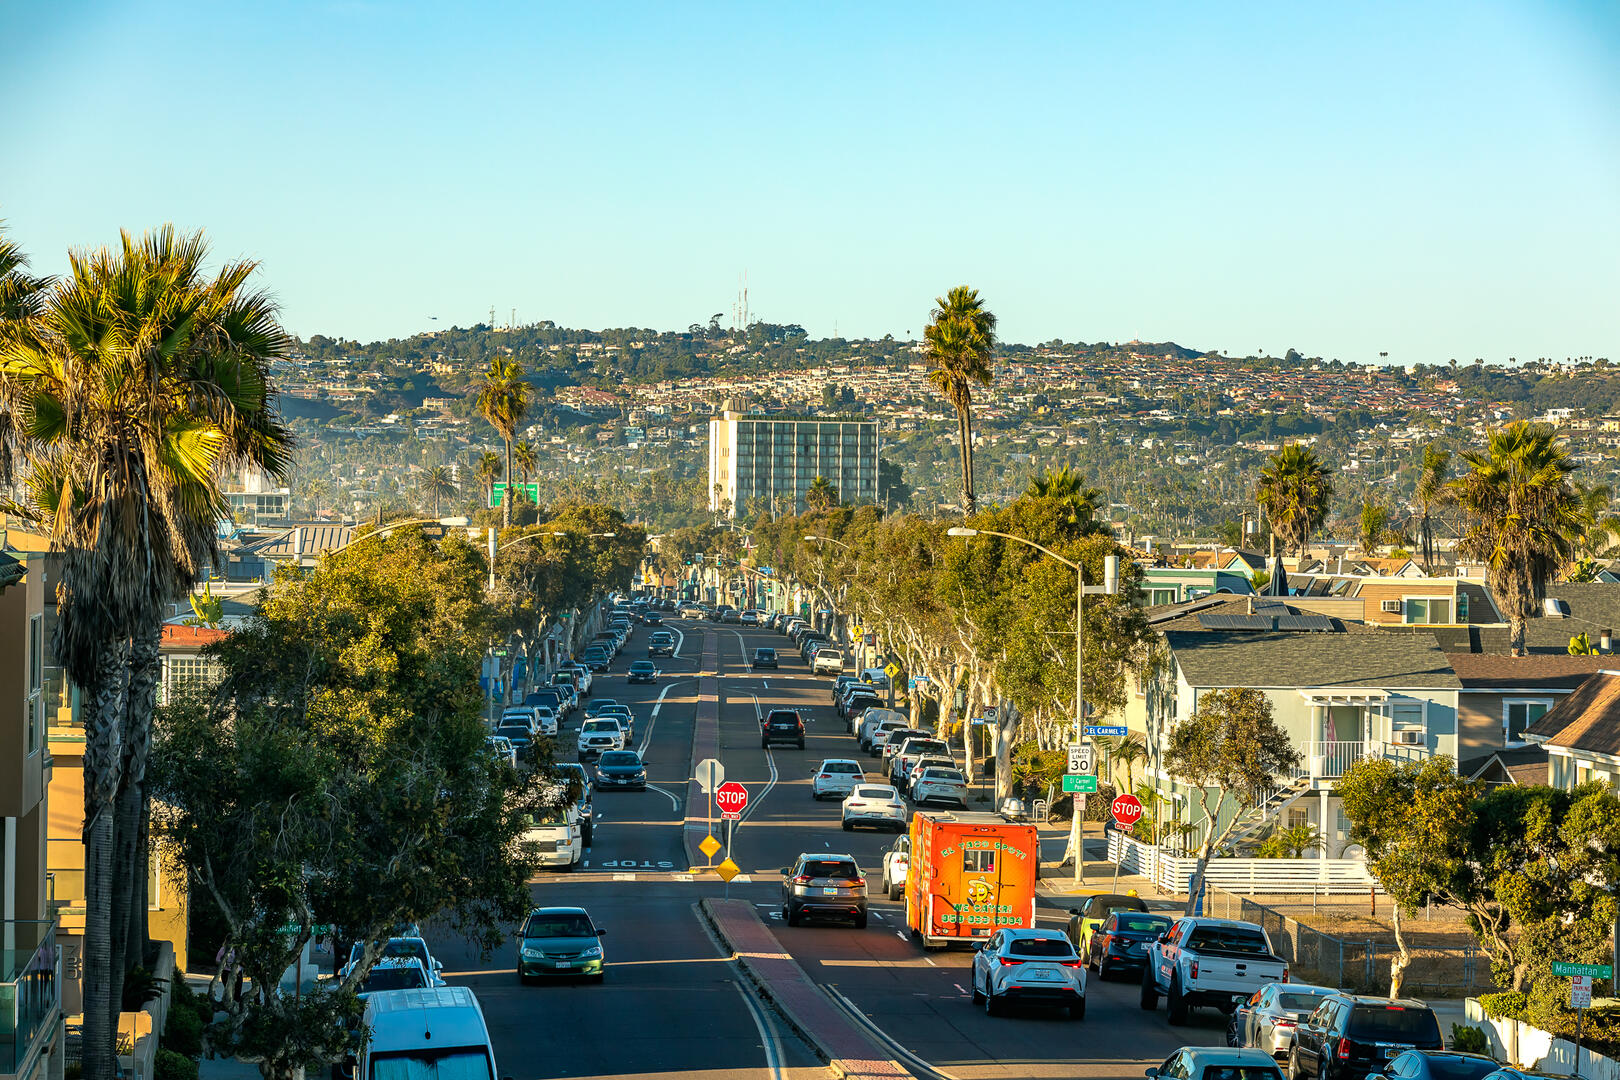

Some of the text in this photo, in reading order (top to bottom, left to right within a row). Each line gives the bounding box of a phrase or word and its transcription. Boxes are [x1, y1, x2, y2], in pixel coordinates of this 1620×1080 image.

[1097, 727, 1119, 735] CARMEL
[1071, 760, 1088, 770] 30
[718, 790, 746, 805] STOP
[1114, 801, 1140, 816] STOP
[940, 847, 956, 859] EL
[958, 840, 989, 850] TACO
[953, 903, 1013, 914] WE CATER!
[1555, 964, 1598, 975] Manhattan
